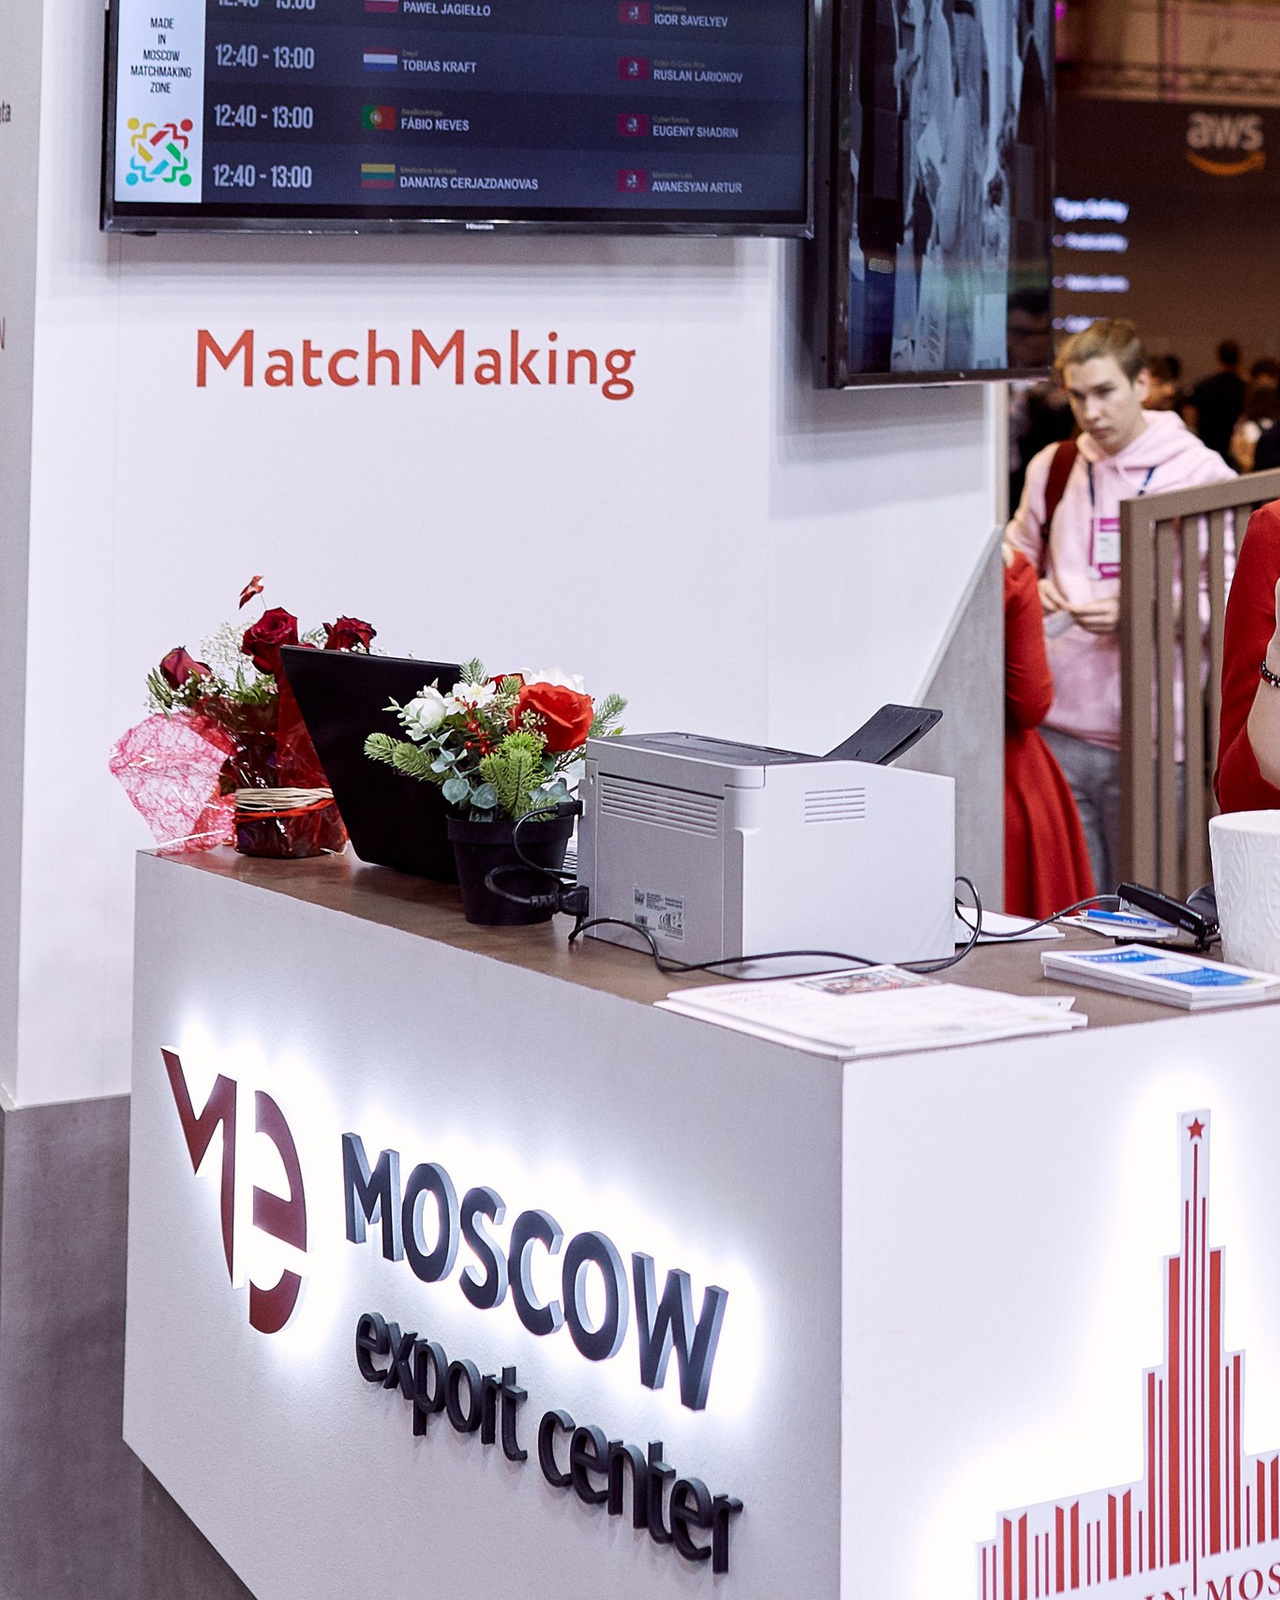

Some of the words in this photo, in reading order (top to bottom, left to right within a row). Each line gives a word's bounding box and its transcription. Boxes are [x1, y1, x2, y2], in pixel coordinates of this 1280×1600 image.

[150, 17, 174, 29] MADE
[654, 13, 679, 25] IGOR
[680, 15, 728, 28] SAVELYEV
[157, 34, 166, 45] IN
[143, 49, 180, 62] MOSCOW
[216, 44, 258, 67] 12:40
[273, 47, 315, 70] 13:00
[130, 65, 192, 79] MATCHMAKING
[402, 59, 441, 72] TOBIAS
[442, 61, 477, 74] KRAFT
[653, 69, 692, 81] RUSLAN
[694, 71, 743, 84] LARIONOV
[150, 82, 171, 94] ZONE
[214, 104, 257, 127] 12:40
[272, 107, 313, 129] 13:00
[435, 119, 470, 131] NEVES
[652, 125, 695, 137] EUGENIY
[696, 127, 739, 138] SHADRIN
[1186, 112, 1264, 150] aws
[213, 165, 255, 187] 12:40
[271, 166, 312, 188] 13:00
[400, 176, 449, 189] DANATAS
[450, 177, 539, 190] CERJAZDANOVAS
[651, 181, 709, 193] AVANESYAN
[710, 182, 743, 194] ARTUR
[196, 329, 636, 400] MatchMaking
[341, 1132, 729, 1411] MOSCOW
[355, 1312, 528, 1461] export
[537, 1409, 743, 1574] center
